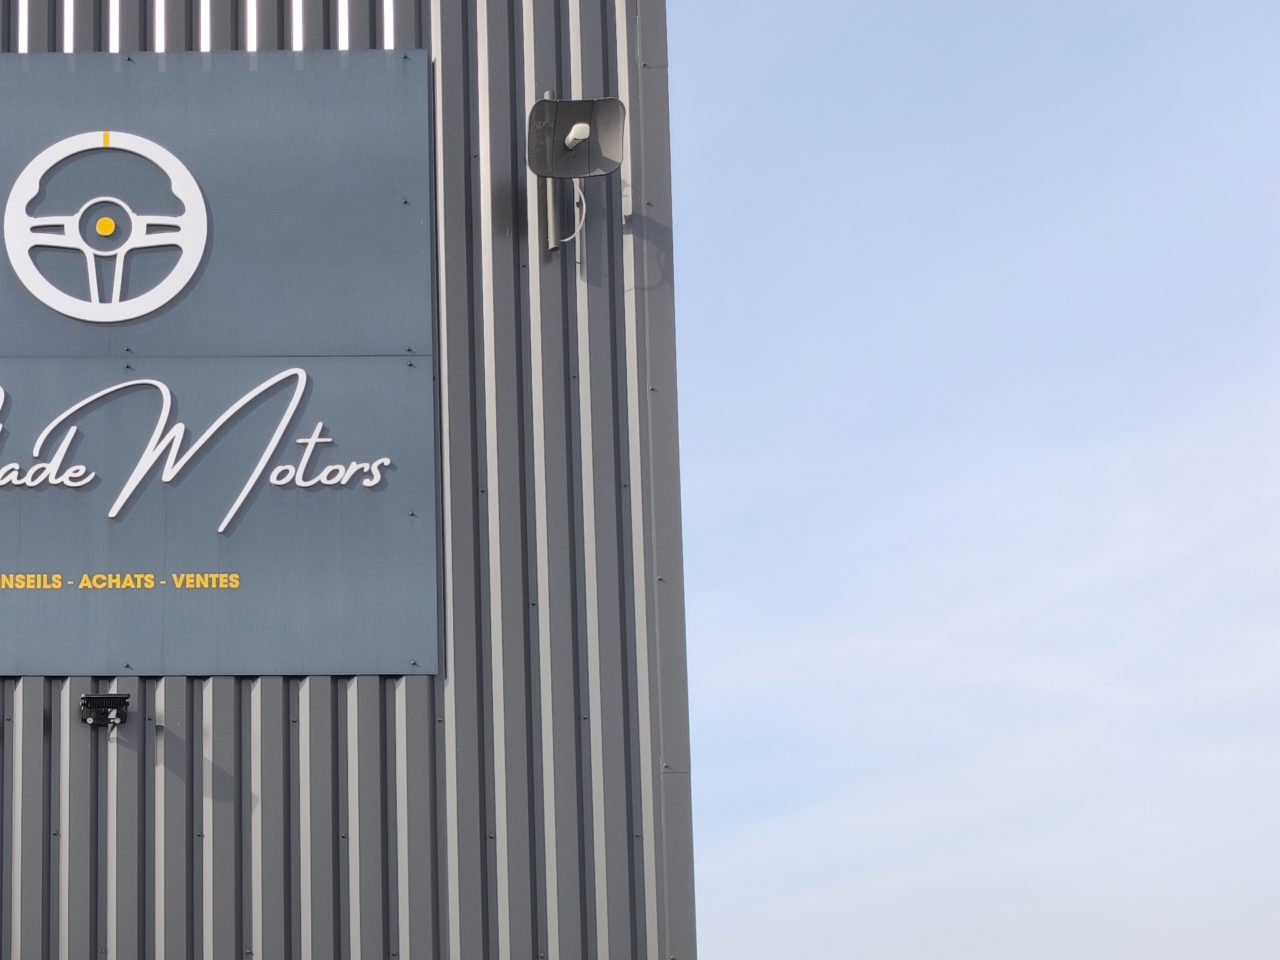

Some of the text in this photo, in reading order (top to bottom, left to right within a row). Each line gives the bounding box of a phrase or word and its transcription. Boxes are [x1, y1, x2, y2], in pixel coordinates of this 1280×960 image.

[32, 367, 391, 533] Motors
[77, 573, 155, 590] ACHATS
[171, 573, 242, 590] VENTES
